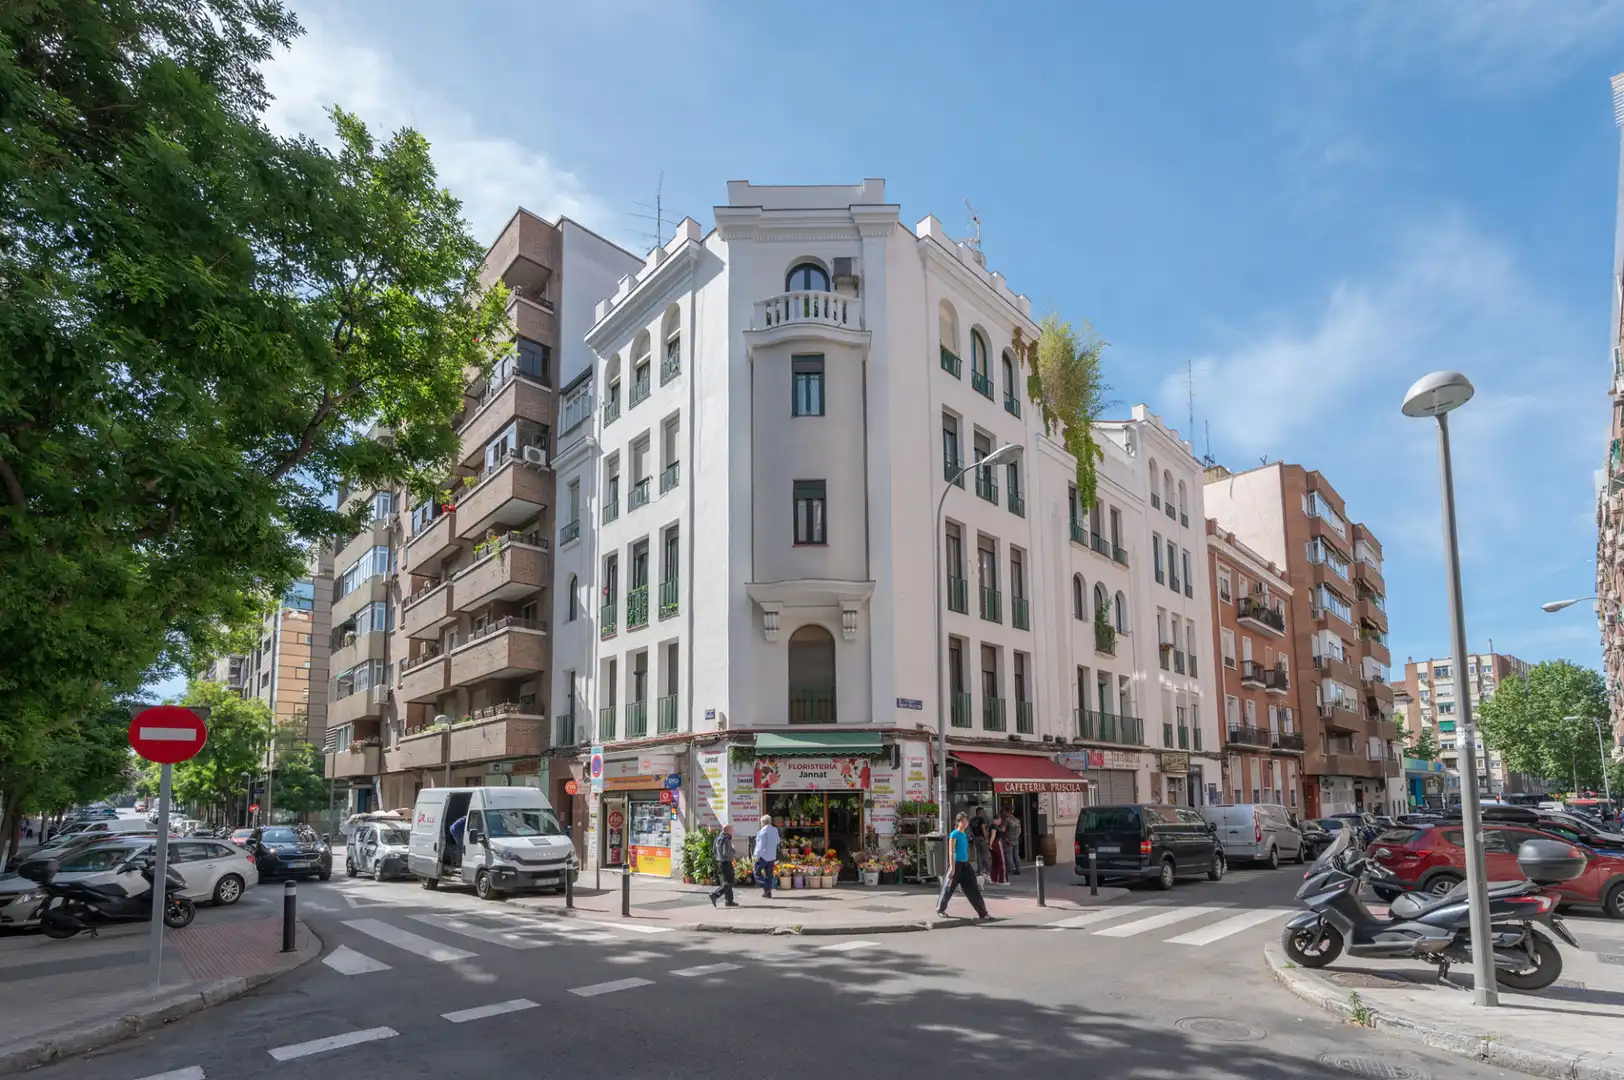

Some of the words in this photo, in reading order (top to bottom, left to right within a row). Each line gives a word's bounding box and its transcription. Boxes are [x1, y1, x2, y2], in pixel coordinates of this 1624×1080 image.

[799, 771, 827, 779] Jannat
[1004, 782, 1047, 792] CAFETERIA
[1050, 782, 1081, 792] PRISCILA
